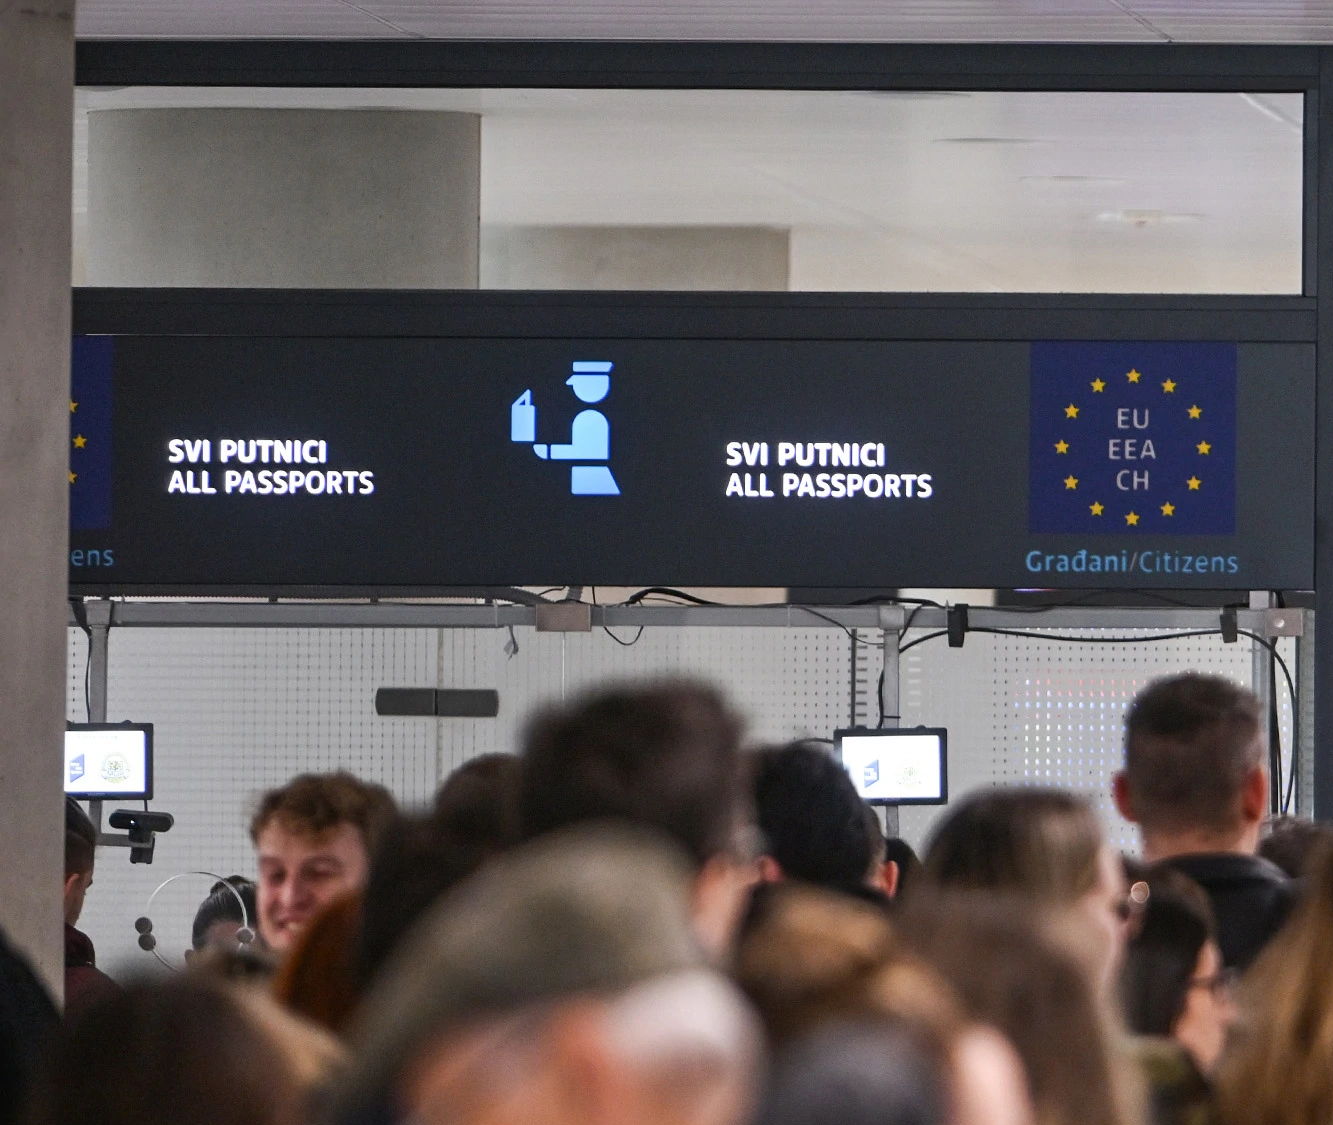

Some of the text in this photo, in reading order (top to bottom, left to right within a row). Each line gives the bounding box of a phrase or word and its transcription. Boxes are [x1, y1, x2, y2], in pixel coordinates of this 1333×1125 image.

[1118, 409, 1148, 428] EU
[169, 439, 328, 463] SVI PUTNICI
[727, 442, 885, 467] SVI PUTNICI
[1109, 440, 1155, 459] EEA
[168, 470, 374, 494] ALL PASSPORTS
[726, 473, 932, 498] ALL PASSPORTS
[1117, 471, 1148, 490] CH
[1026, 550, 1238, 573] Građani/Citizens
